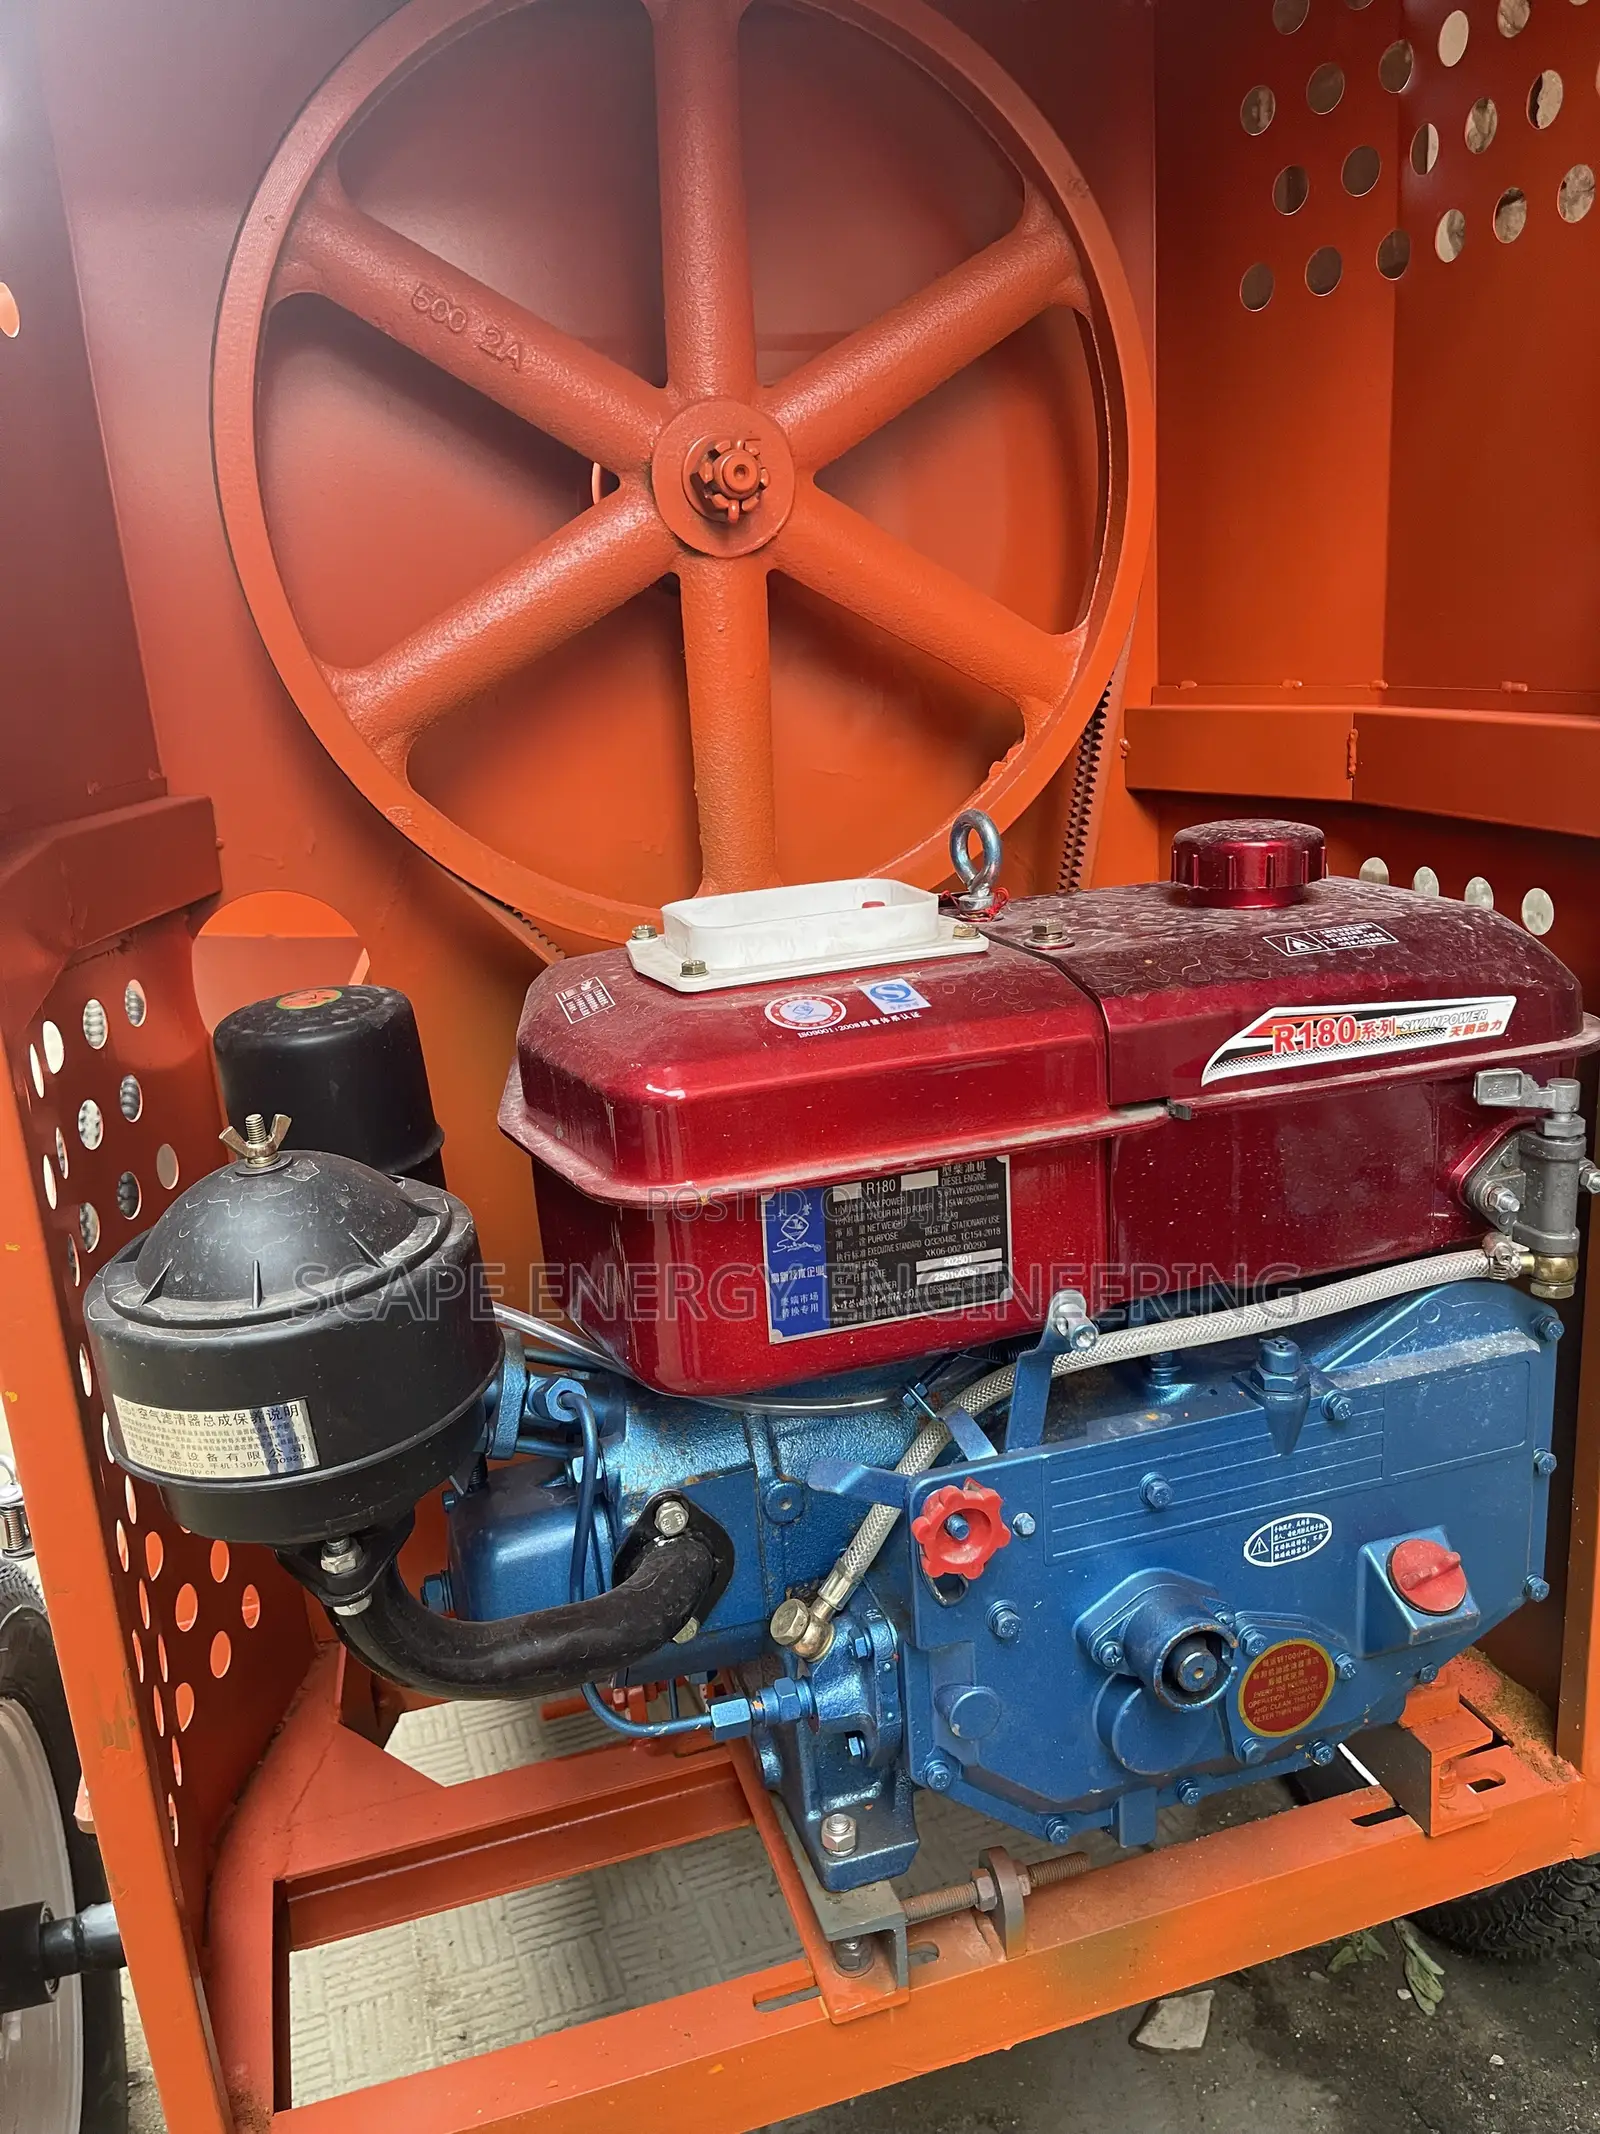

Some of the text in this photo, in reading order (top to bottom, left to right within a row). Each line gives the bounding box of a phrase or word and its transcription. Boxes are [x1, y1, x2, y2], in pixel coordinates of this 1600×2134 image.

[1401, 1008, 1489, 1033] SWANPOWER
[866, 1178, 897, 1196] R180
[941, 1170, 987, 1187] DIESEL ENGINE
[881, 1196, 906, 1209] POWER
[891, 1205, 911, 1217] RATED
[912, 1202, 934, 1214] POWER
[866, 1222, 880, 1233] NET
[880, 1218, 907, 1231] WEIGHT
[867, 1231, 899, 1245] PURPOSE
[951, 1217, 987, 1230] STATIONARY
[988, 1214, 1001, 1225] USE
[867, 1243, 896, 1257] EXECUTIVE
[895, 1240, 922, 1252] STANDARD
[869, 1268, 887, 1280] DATE
[943, 1254, 973, 1268] 202501
[1248, 1692, 1285, 1709] OPERATION
